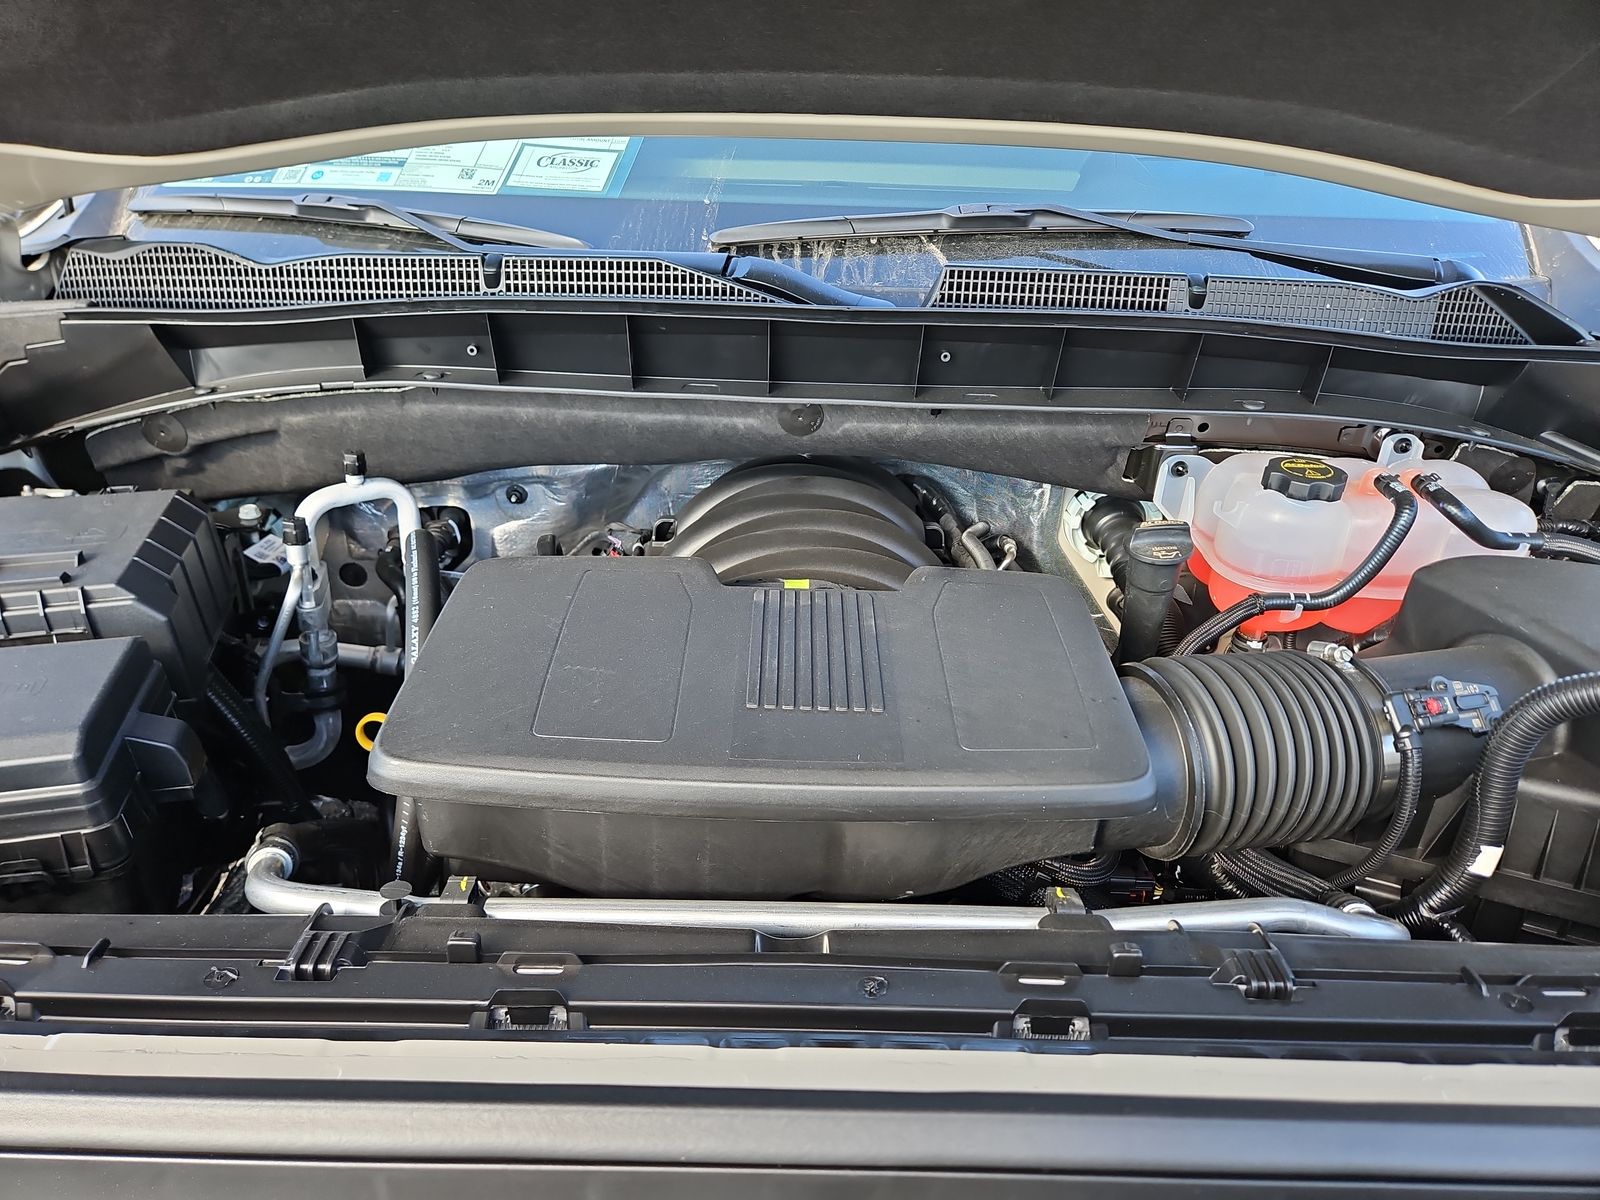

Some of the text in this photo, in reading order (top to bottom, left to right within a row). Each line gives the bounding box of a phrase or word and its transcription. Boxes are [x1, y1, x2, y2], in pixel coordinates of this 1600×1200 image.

[537, 156, 601, 168] CLASSIC
[398, 826, 408, 857] R-1234yf
[395, 862, 403, 881] -134a
